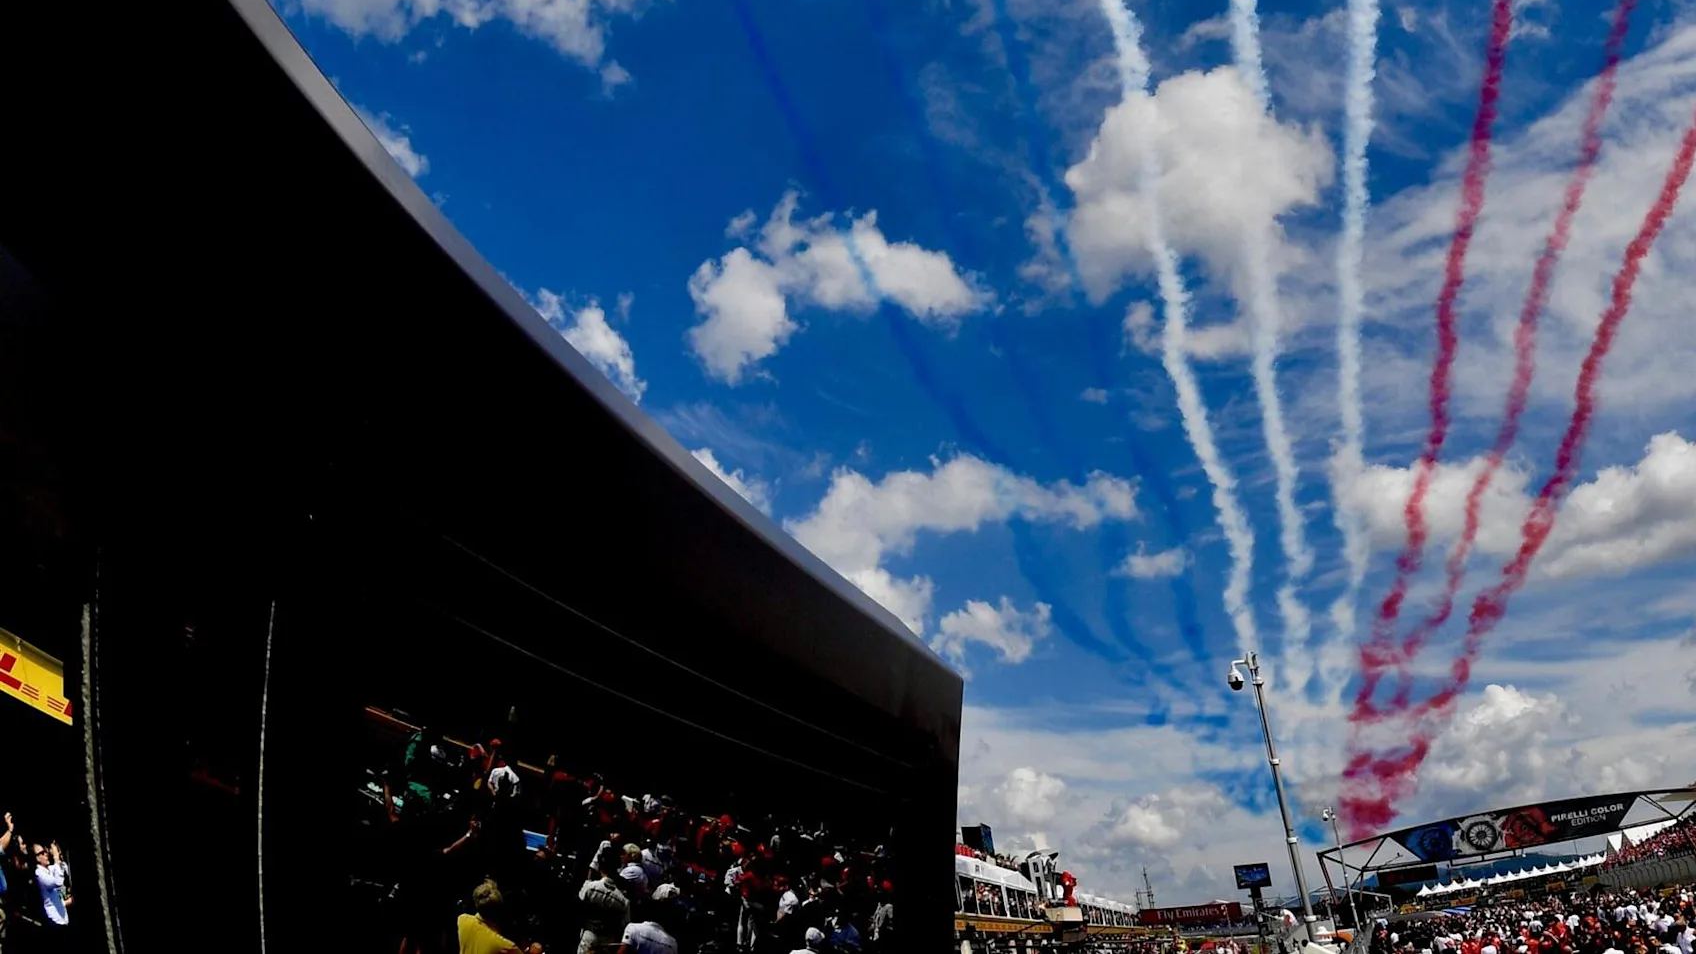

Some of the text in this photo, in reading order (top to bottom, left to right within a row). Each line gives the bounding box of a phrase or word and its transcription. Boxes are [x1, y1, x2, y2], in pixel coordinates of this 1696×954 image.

[1551, 803, 1625, 823] PIRELLI COLOR
[1571, 814, 1607, 827] EDITION
[1157, 907, 1221, 921] Fly Emirates
